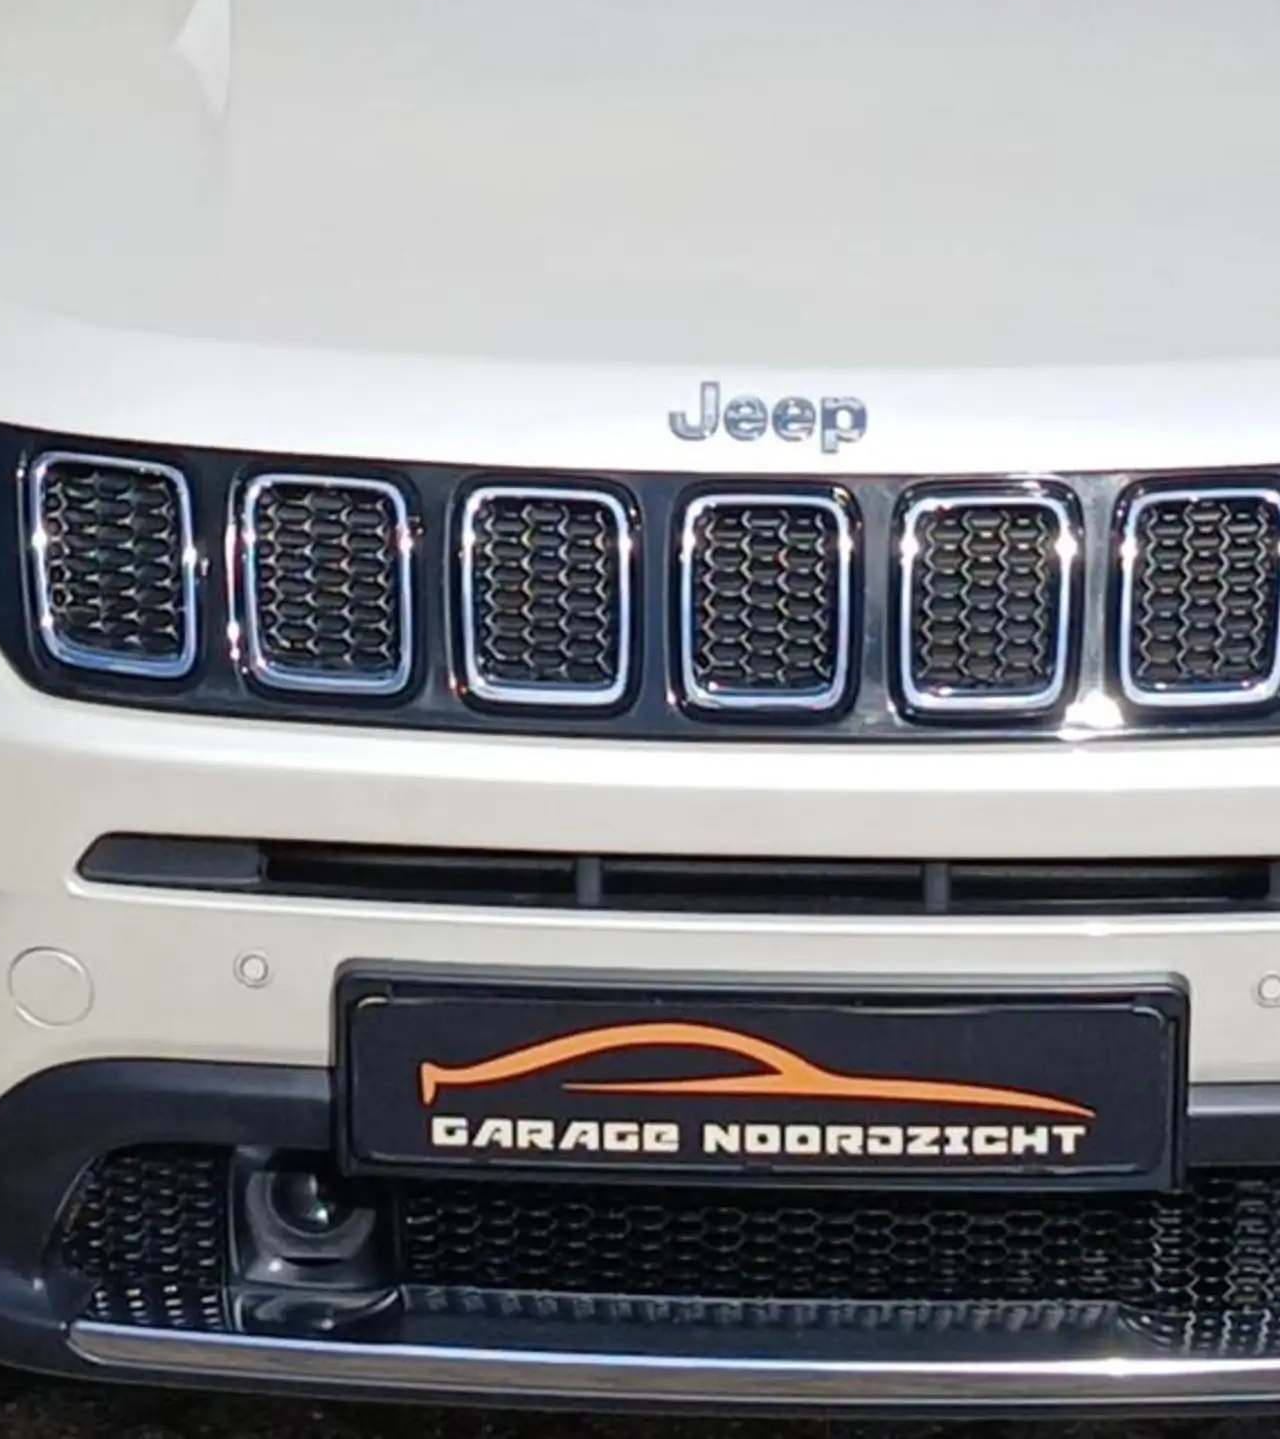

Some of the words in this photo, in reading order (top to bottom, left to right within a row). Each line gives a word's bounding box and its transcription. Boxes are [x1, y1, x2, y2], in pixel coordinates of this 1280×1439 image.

[668, 380, 869, 454] Jeep
[431, 1116, 680, 1153] GARAGE
[702, 1122, 1088, 1156] NOORDZICHT
